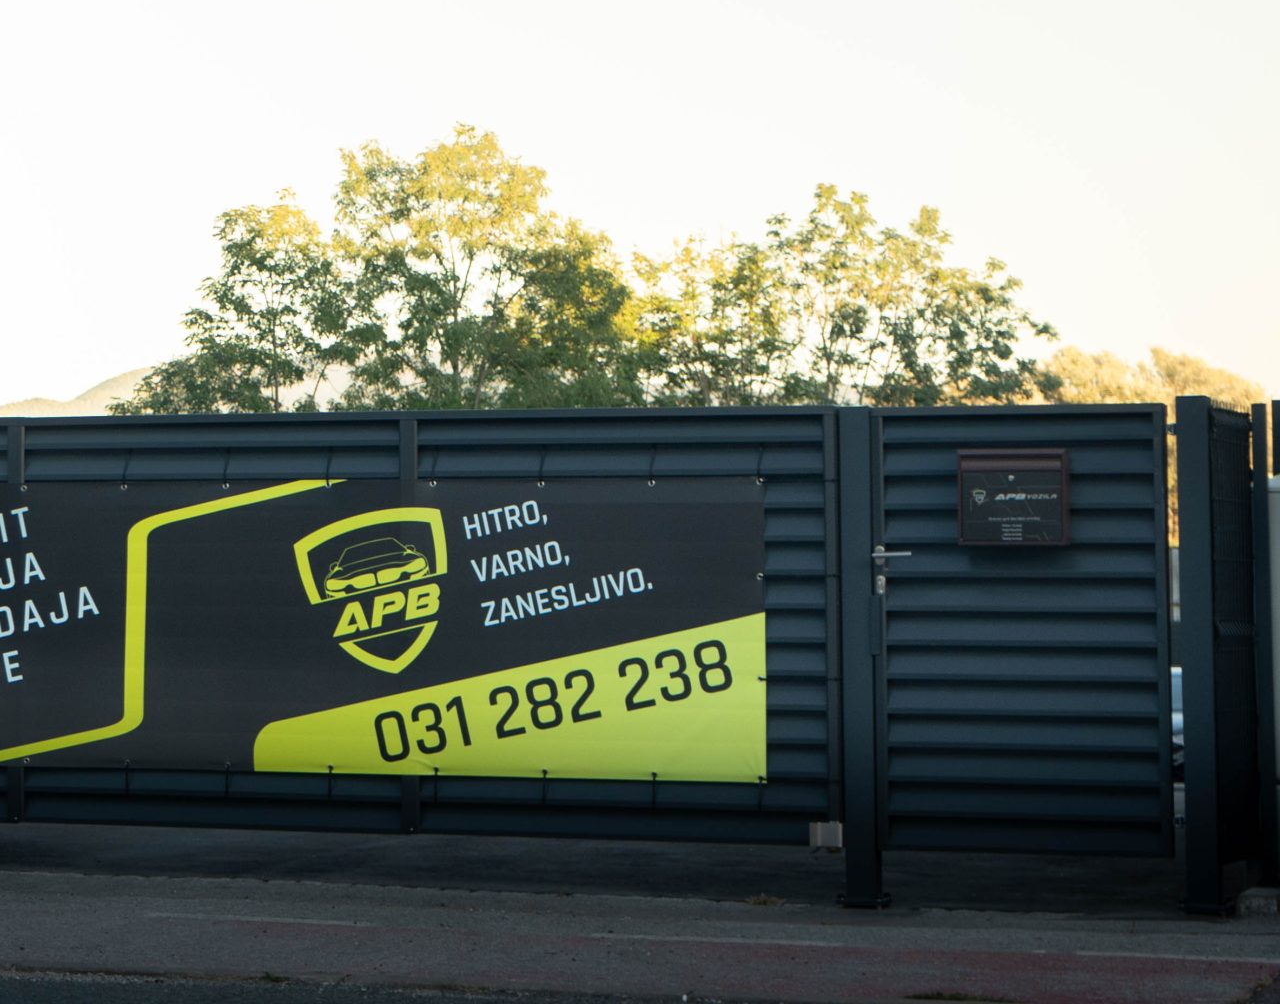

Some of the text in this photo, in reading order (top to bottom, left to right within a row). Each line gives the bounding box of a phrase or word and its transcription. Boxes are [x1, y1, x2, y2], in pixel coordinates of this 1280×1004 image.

[462, 499, 548, 541] HITRO,
[994, 492, 1027, 501] APB
[469, 540, 571, 583] VARNO,
[332, 582, 441, 638] APB
[480, 567, 654, 627] ZANESLJIVO.
[374, 640, 733, 763] 031 282 238
